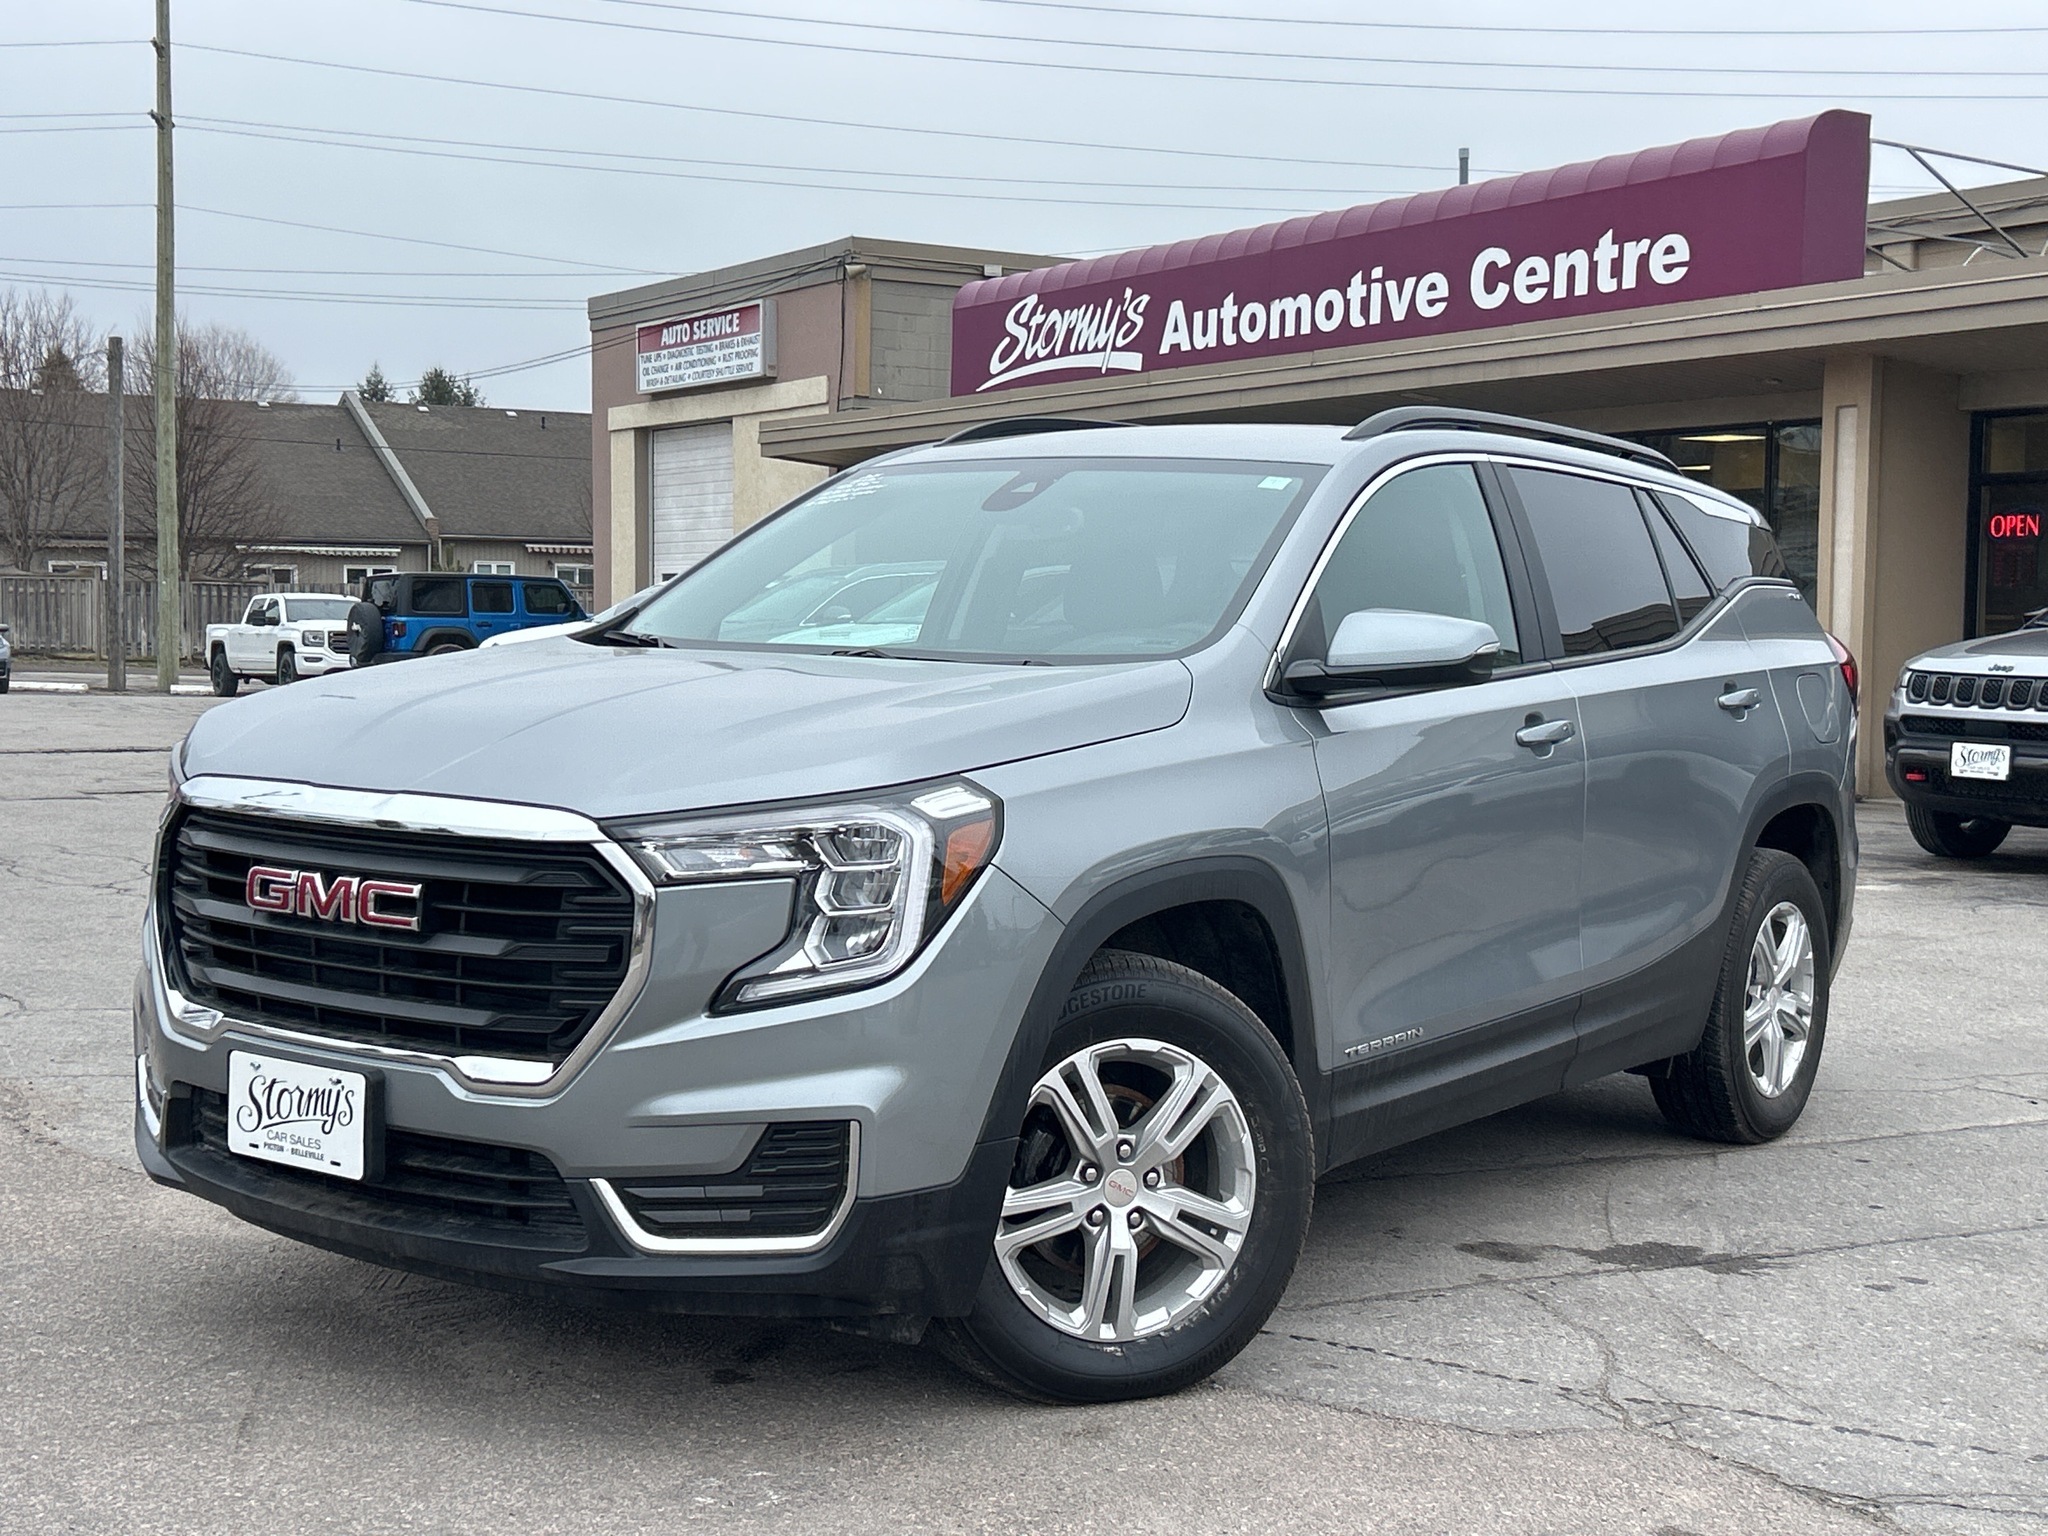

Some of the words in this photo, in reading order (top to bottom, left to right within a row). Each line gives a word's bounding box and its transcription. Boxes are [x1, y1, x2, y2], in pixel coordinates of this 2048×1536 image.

[990, 287, 1151, 374] Stormy's
[1158, 266, 1449, 355] Automotive
[1469, 229, 1691, 311] Centre
[661, 322, 690, 347] AUTO
[693, 312, 740, 340] SERVICE
[640, 354, 652, 364] TUNE
[654, 352, 662, 363] UPS
[667, 347, 695, 360] DIAGNOSTIC
[719, 339, 735, 351] BRAKES
[741, 334, 760, 347] EXHAUST
[642, 367, 650, 377] OIL
[651, 363, 669, 375] CHANGE
[683, 355, 716, 370] CONDITIONING
[723, 351, 734, 363] RUST
[735, 347, 759, 360] PROOFING
[664, 373, 687, 385] DETAILING
[692, 369, 715, 381] COURTESY
[715, 365, 735, 377] SHUTTLE
[736, 362, 754, 374] SERVICE
[1990, 513, 2039, 537] OPEN
[1955, 748, 2006, 767] Stormy's
[246, 866, 422, 931] GMC
[1344, 1026, 1424, 1057] TERRAIN
[236, 1074, 355, 1135] Stormy's
[263, 1141, 285, 1153] PICTON
[290, 1147, 325, 1162] BELLEVILLE
[266, 1129, 288, 1143] CAR
[289, 1134, 322, 1150] SALES
[1108, 1180, 1134, 1198] GMC
